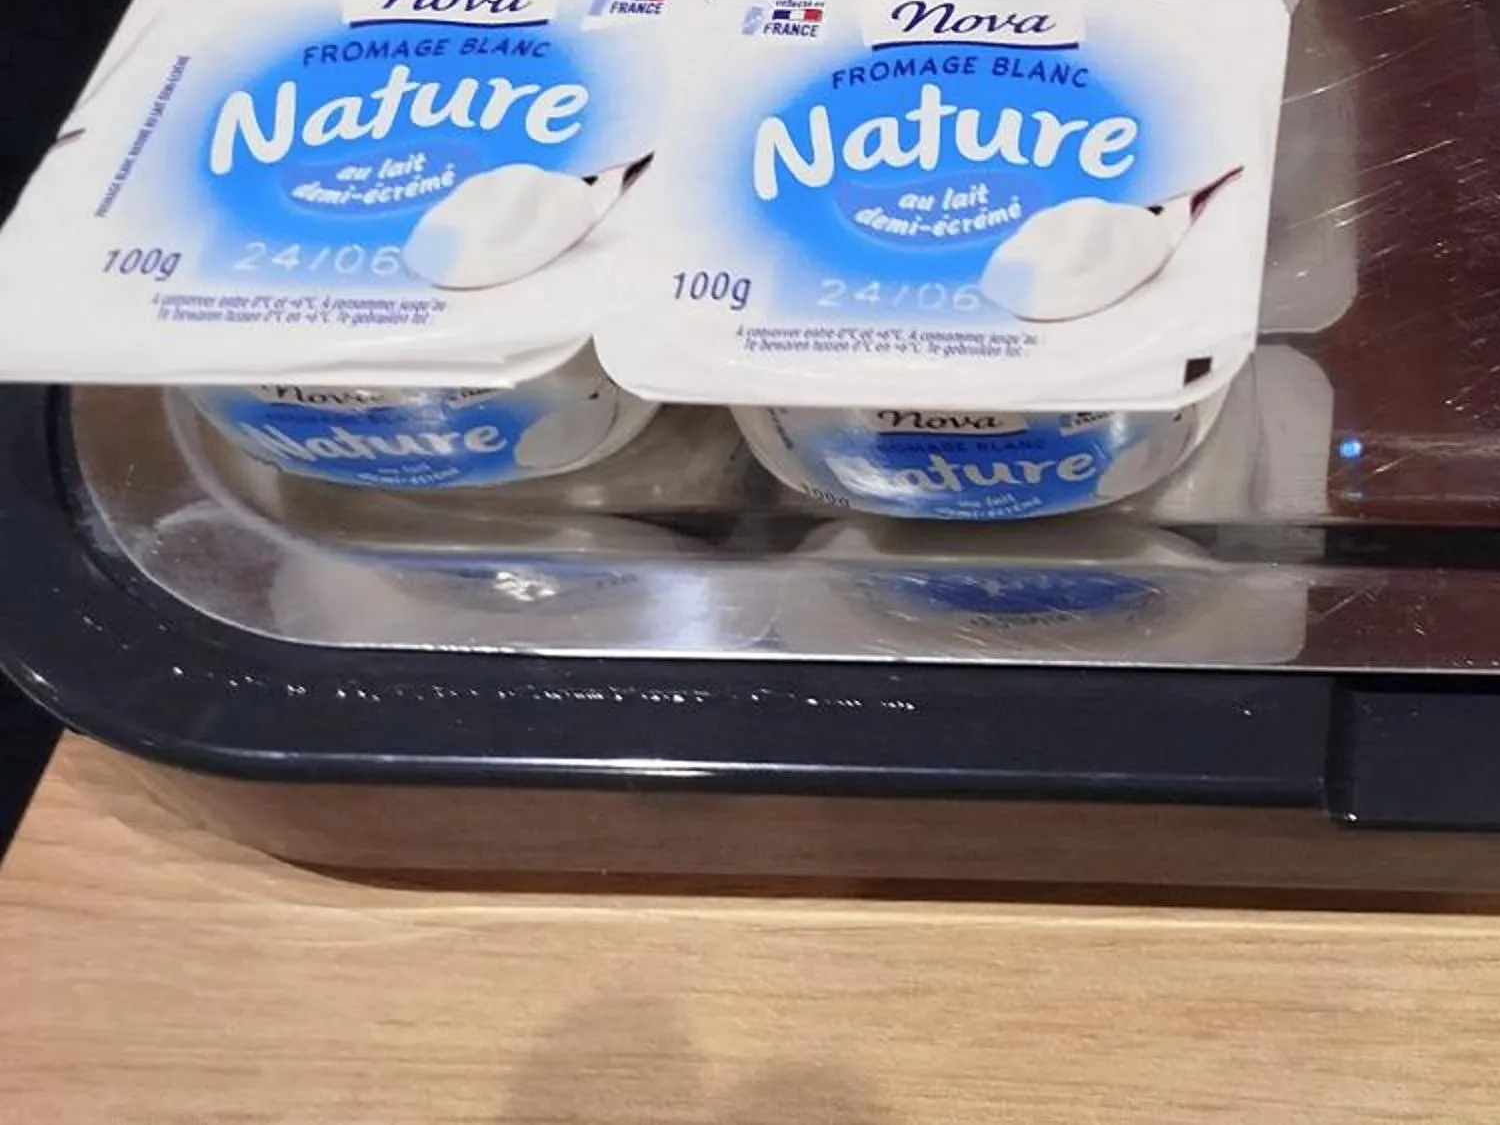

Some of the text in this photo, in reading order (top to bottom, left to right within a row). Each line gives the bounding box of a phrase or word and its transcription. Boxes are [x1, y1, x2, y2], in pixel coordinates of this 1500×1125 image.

[609, 1, 665, 15] FRANCE
[890, 0, 1057, 35] Nova
[763, 22, 821, 38] FRANCE
[302, 37, 552, 68] FROMAGE BLANC
[831, 55, 1089, 90] FROMAGE BLANC
[209, 63, 591, 176] Nature
[752, 82, 1140, 201] Nature
[336, 151, 427, 182] au lait
[898, 182, 990, 212] au lait
[101, 247, 183, 282] 100g
[232, 241, 403, 276] 24/06
[671, 271, 753, 311] 100g
[876, 409, 1000, 431] Nova
